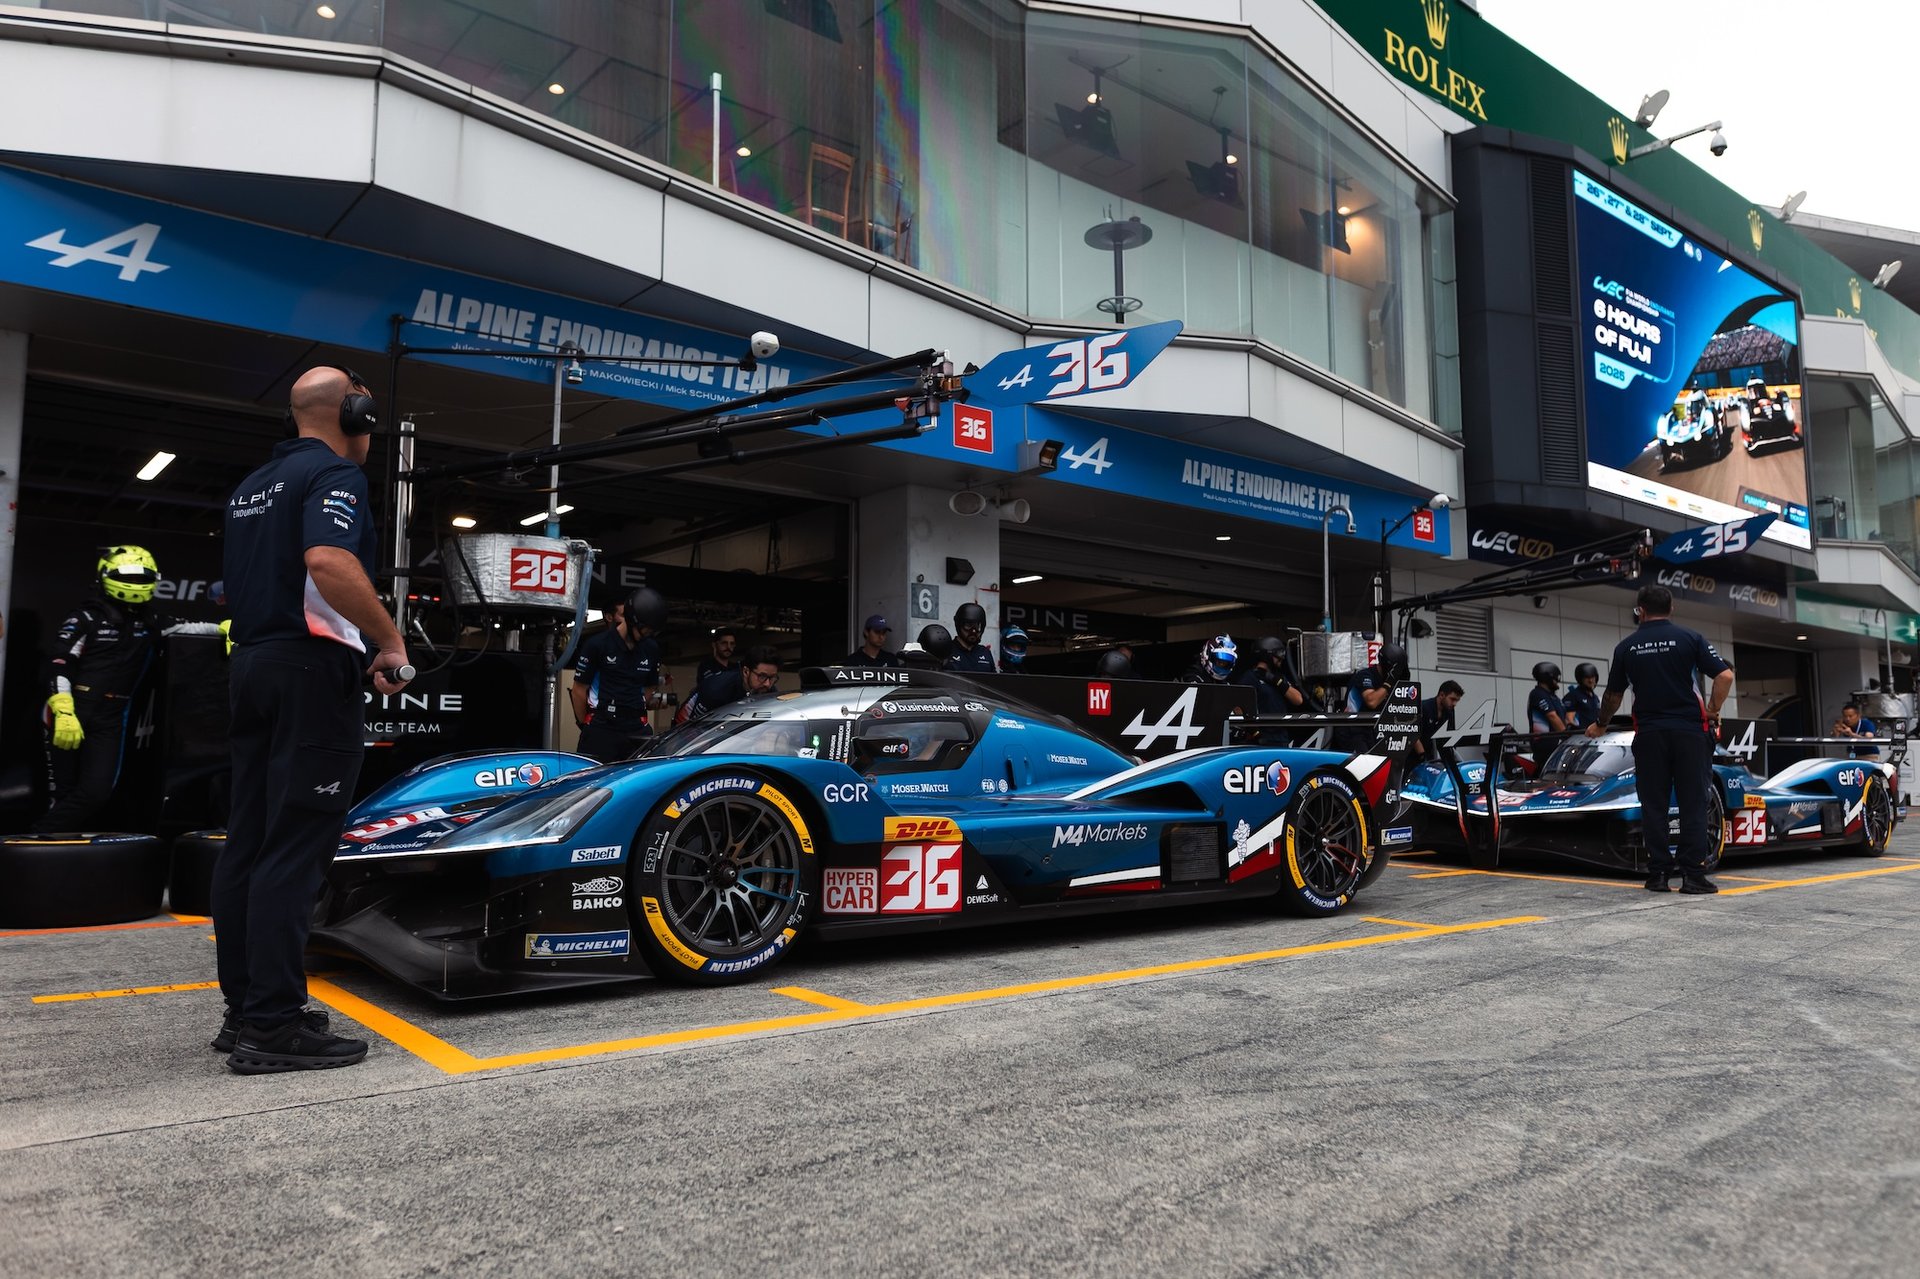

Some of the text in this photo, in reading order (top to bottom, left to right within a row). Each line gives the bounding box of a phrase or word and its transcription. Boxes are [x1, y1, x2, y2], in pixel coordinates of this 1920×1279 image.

[1384, 28, 1488, 121] ROLEX
[1593, 299, 1661, 344] 6 HOURS
[411, 289, 790, 394] ALPINE ENDURANCE TEAM
[1595, 325, 1652, 365] OF FUJI
[1046, 332, 1128, 397] 36
[1599, 362, 1625, 382] 2025
[589, 368, 659, 390] MAKOWIECKI
[665, 384, 687, 396] Mick
[960, 417, 986, 440] 36
[229, 482, 285, 506] ALPINE
[1182, 458, 1350, 516] ALPINE ENDURANCE TEAM
[1416, 516, 1431, 533] 35
[1700, 519, 1748, 557] 35
[512, 553, 565, 590] 36
[152, 579, 206, 600] elf
[918, 588, 933, 614] 6
[1629, 640, 1677, 652] ALPINE
[835, 670, 910, 683] ALPINE
[1089, 689, 1109, 710] HY
[1394, 687, 1409, 698] elf
[899, 702, 960, 713] businessolver
[1387, 703, 1418, 714] devoteam
[399, 722, 441, 733] TEAM
[882, 745, 898, 753] elf
[474, 767, 517, 787] elf
[1223, 765, 1267, 794] elf
[1467, 769, 1481, 780] elf
[1727, 778, 1740, 789] GCR
[1838, 770, 1855, 786] elf
[689, 777, 756, 801] MICHELIN
[824, 783, 869, 803] GCR
[891, 783, 949, 793] MOSER.WATCH
[982, 782, 994, 790] FIA
[1323, 776, 1353, 797] MICHELIN
[764, 787, 799, 821] PILOT SPORT
[895, 820, 954, 839] DHL
[1735, 810, 1766, 844] 35
[801, 838, 812, 849] M
[577, 848, 617, 861] Sabelt
[826, 871, 874, 886] HYPER
[881, 844, 961, 911] 36
[572, 897, 623, 910] BAHCO
[826, 886, 874, 909] CAR
[966, 894, 999, 905] DEWESoft
[1304, 888, 1337, 908] MICHELIN
[647, 902, 659, 914] M
[554, 938, 627, 952] MICHELIN
[661, 932, 700, 966] PILOT SPORT
[709, 945, 776, 973] MICHELIN
